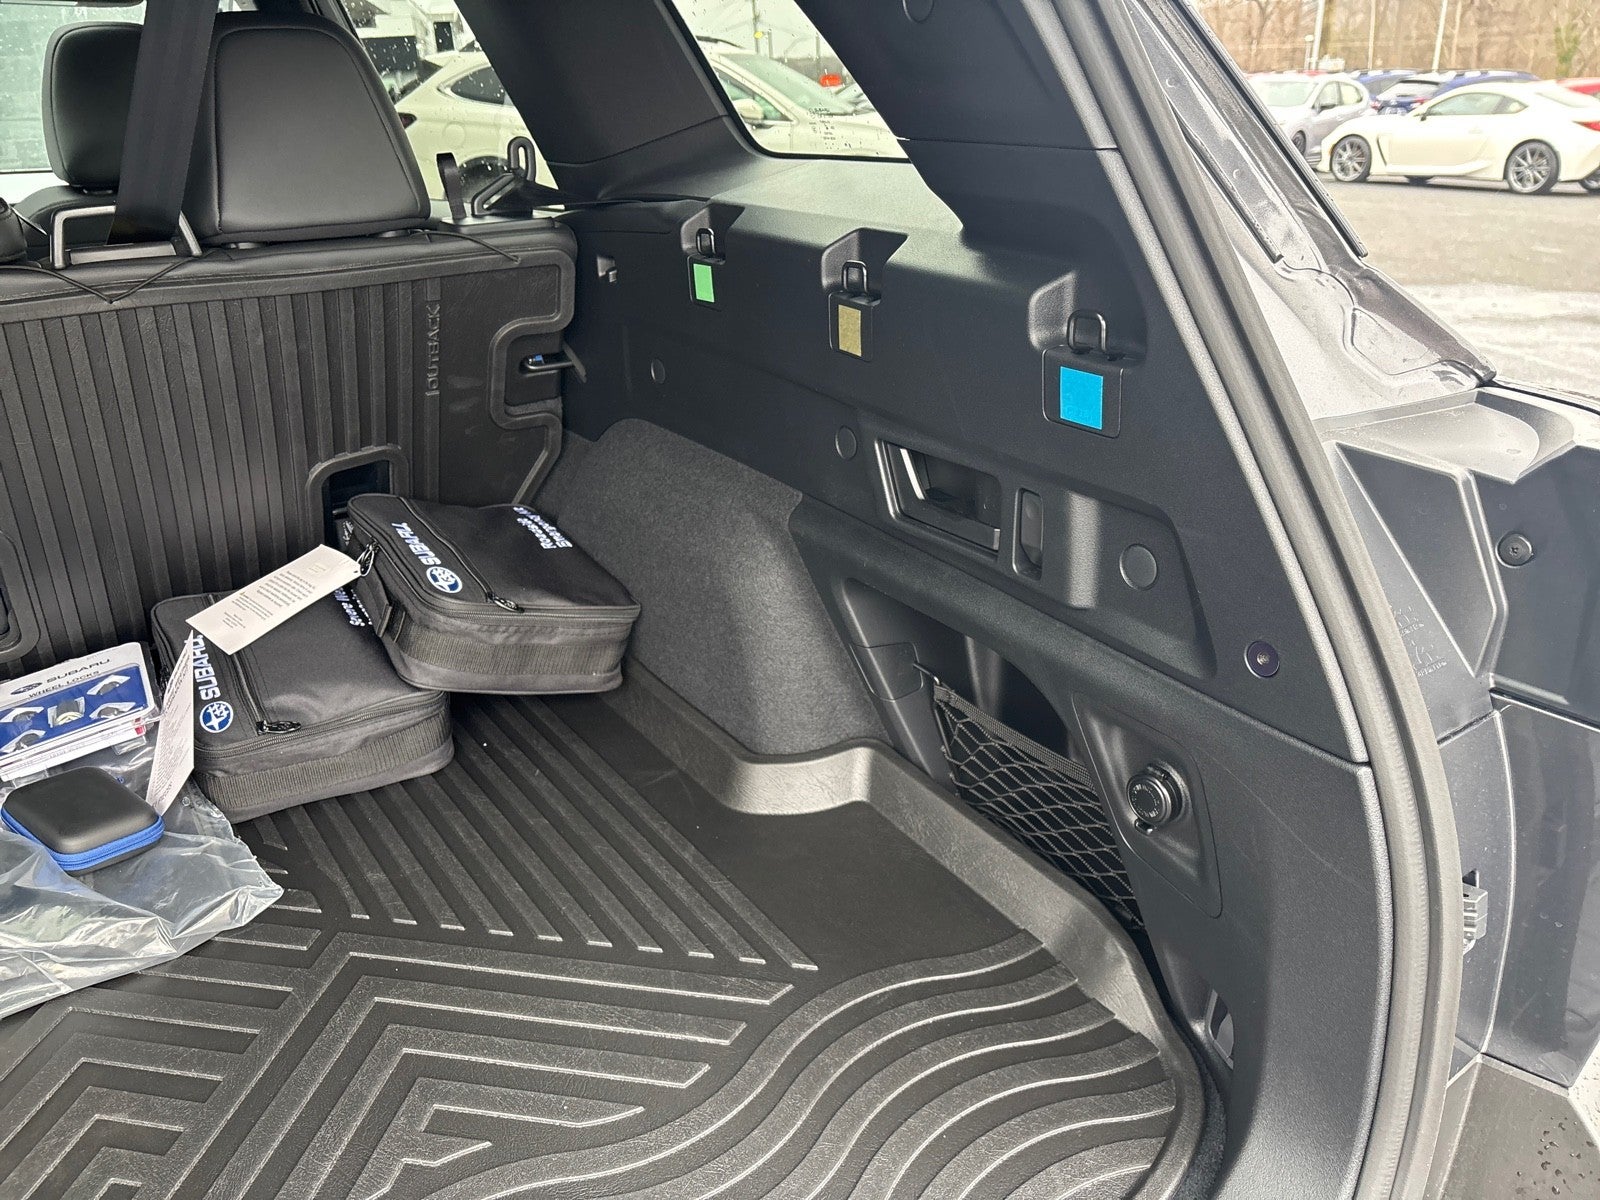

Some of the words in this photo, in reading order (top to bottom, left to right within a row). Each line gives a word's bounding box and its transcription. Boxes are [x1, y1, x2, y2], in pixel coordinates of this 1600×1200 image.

[426, 303, 441, 389] OUTBACK
[391, 522, 441, 566] SUBARU
[28, 683, 65, 698] WHEEL
[66, 670, 100, 685] LOCKS
[46, 658, 110, 684] SUBARU
[184, 634, 221, 701] SUBARU
